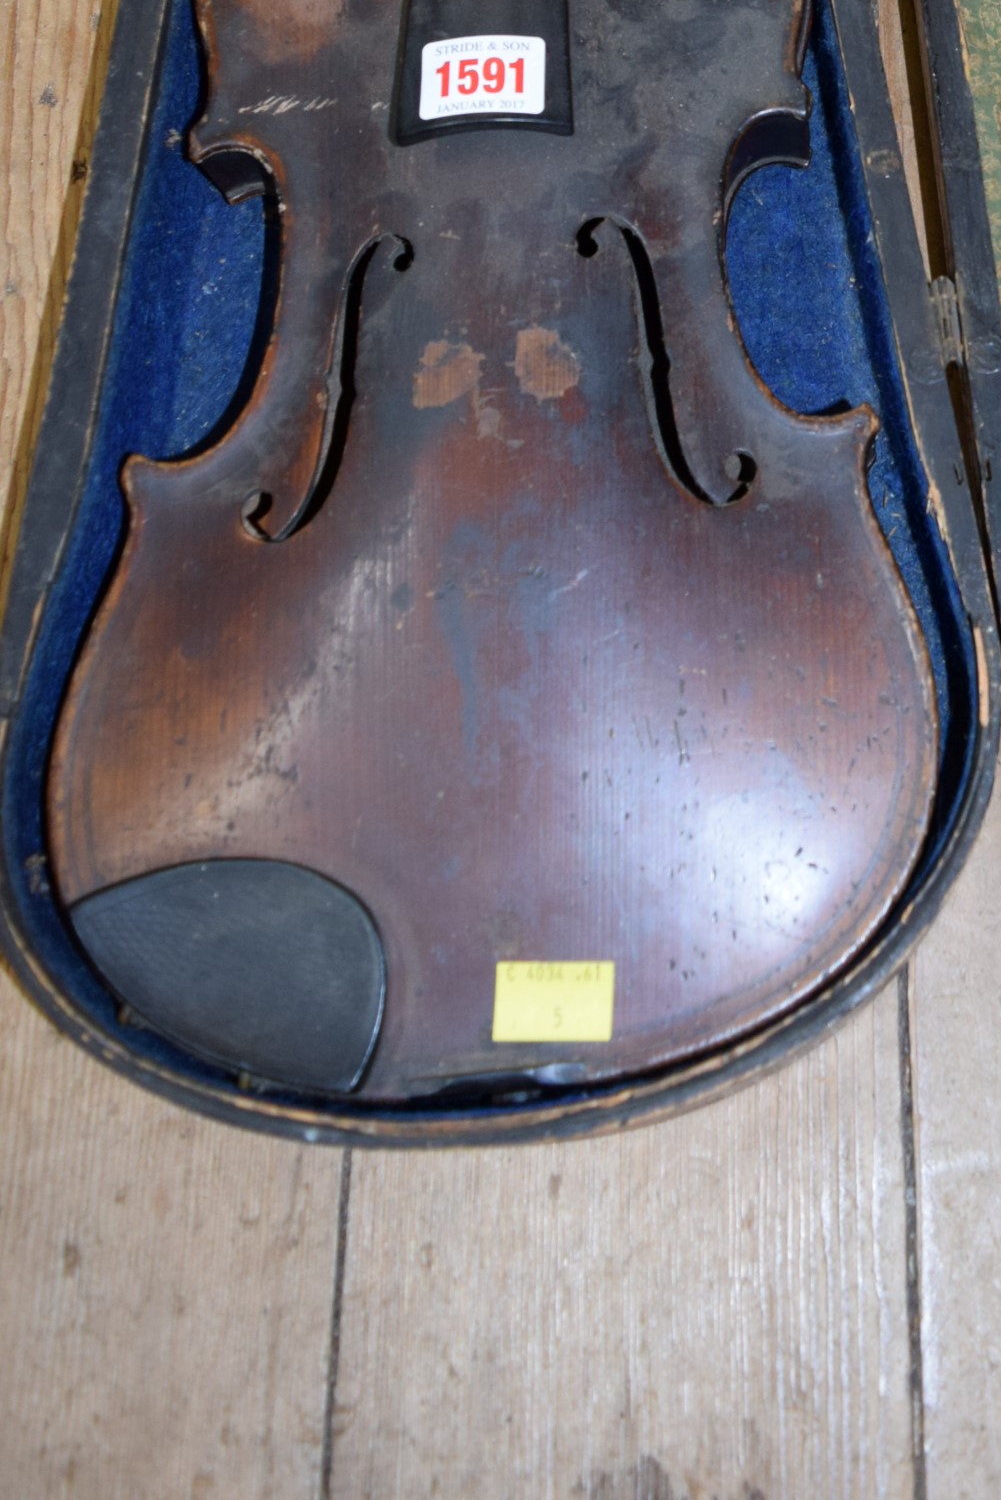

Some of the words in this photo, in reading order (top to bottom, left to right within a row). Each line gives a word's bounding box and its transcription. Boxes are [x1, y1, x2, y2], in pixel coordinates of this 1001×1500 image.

[435, 43, 483, 56] STRIDE
[487, 42, 496, 51] &
[502, 41, 531, 51] SON
[435, 57, 524, 98] 1591
[436, 100, 495, 113] JANUARY
[499, 99, 525, 109] 2017
